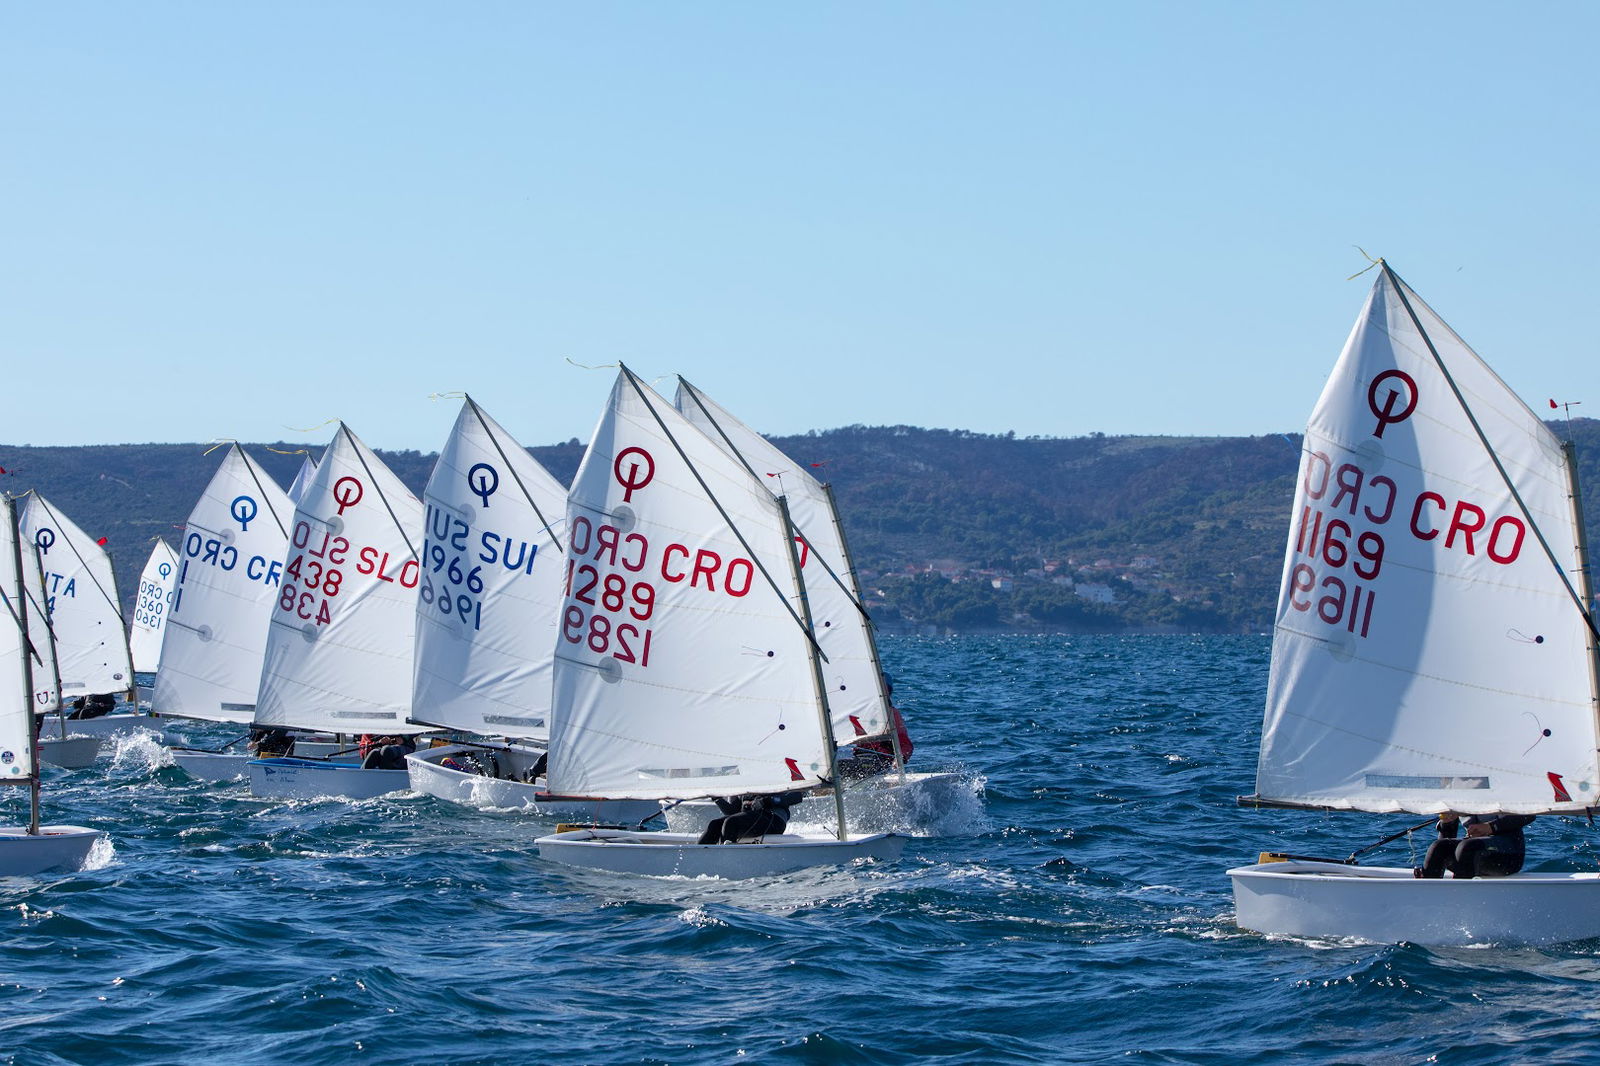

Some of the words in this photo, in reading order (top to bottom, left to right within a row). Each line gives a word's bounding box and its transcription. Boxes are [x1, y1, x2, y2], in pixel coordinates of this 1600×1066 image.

[1296, 505, 1385, 581] 1169
[1409, 491, 1526, 565] CRO
[247, 555, 283, 588] CR
[355, 546, 419, 589] SLO
[422, 539, 484, 594] 1966
[479, 531, 538, 575] SUI
[661, 543, 754, 598] CRO
[44, 571, 76, 598] ITA
[286, 555, 343, 597] 438
[566, 558, 656, 622] 1289
[138, 594, 163, 615] 1360
